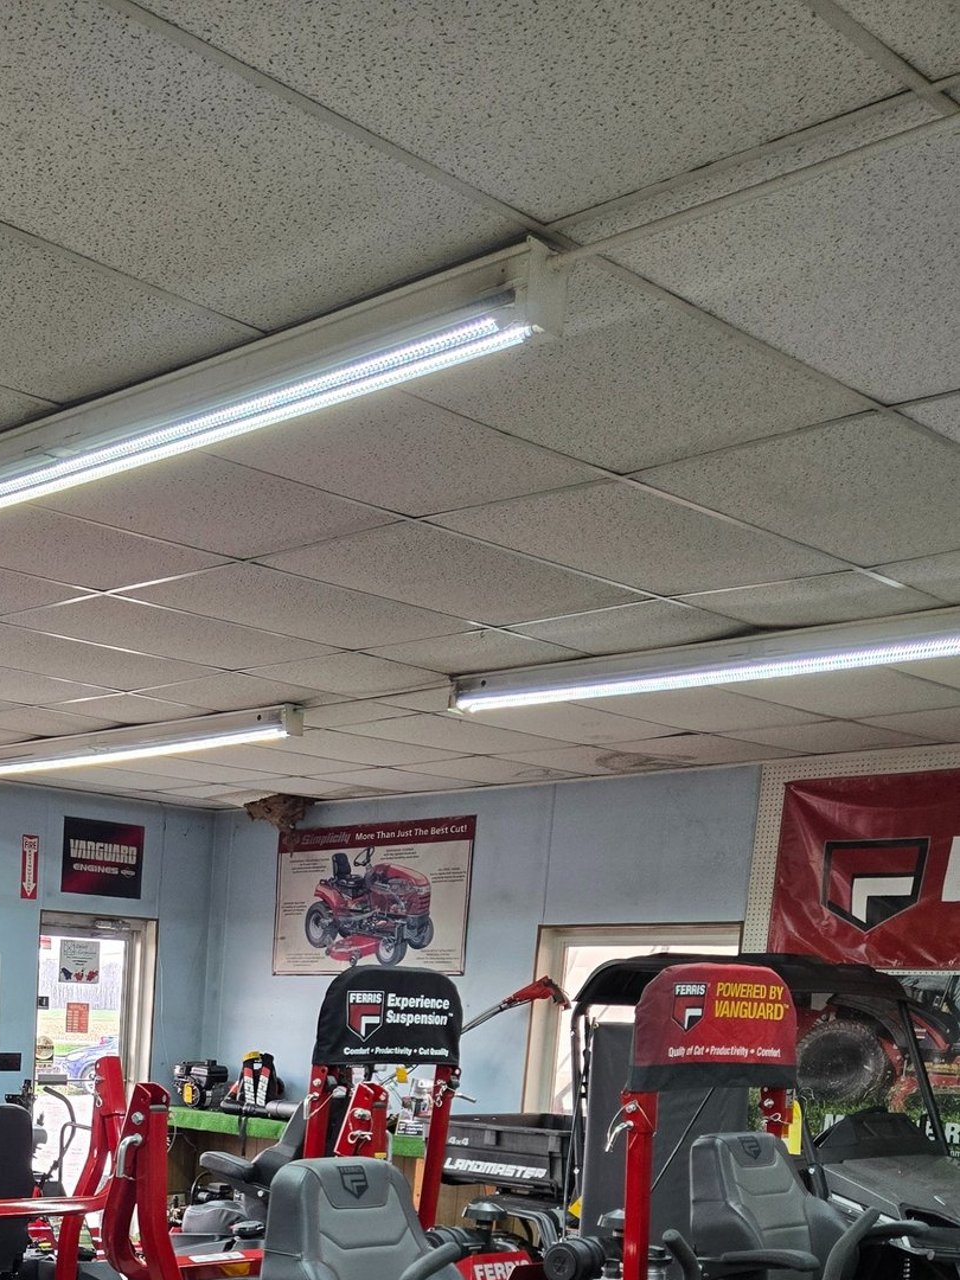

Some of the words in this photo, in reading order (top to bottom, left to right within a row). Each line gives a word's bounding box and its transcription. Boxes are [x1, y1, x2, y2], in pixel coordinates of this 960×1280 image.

[301, 832, 352, 846] Simplicity
[355, 832, 375, 841] More
[376, 830, 396, 839] Than
[397, 829, 413, 838] Just
[414, 827, 429, 836] The
[430, 826, 449, 835] Best
[450, 824, 468, 833] Cut!
[69, 839, 137, 865] VANGUARD
[73, 863, 119, 875] ENGINES
[675, 984, 706, 996] FERRIS
[716, 982, 767, 999] POWERED
[769, 985, 784, 1000] BY
[350, 992, 382, 1004] FERRIS
[387, 993, 450, 1010] Experience
[714, 1000, 784, 1021] VANGUARD
[343, 1046, 370, 1056] Comfort
[375, 1046, 413, 1057] Productivity
[709, 1045, 748, 1058] Productivity
[756, 1047, 781, 1058] Comfort
[448, 1136, 469, 1146] 4x4
[443, 1157, 548, 1179] LANDMASTER
